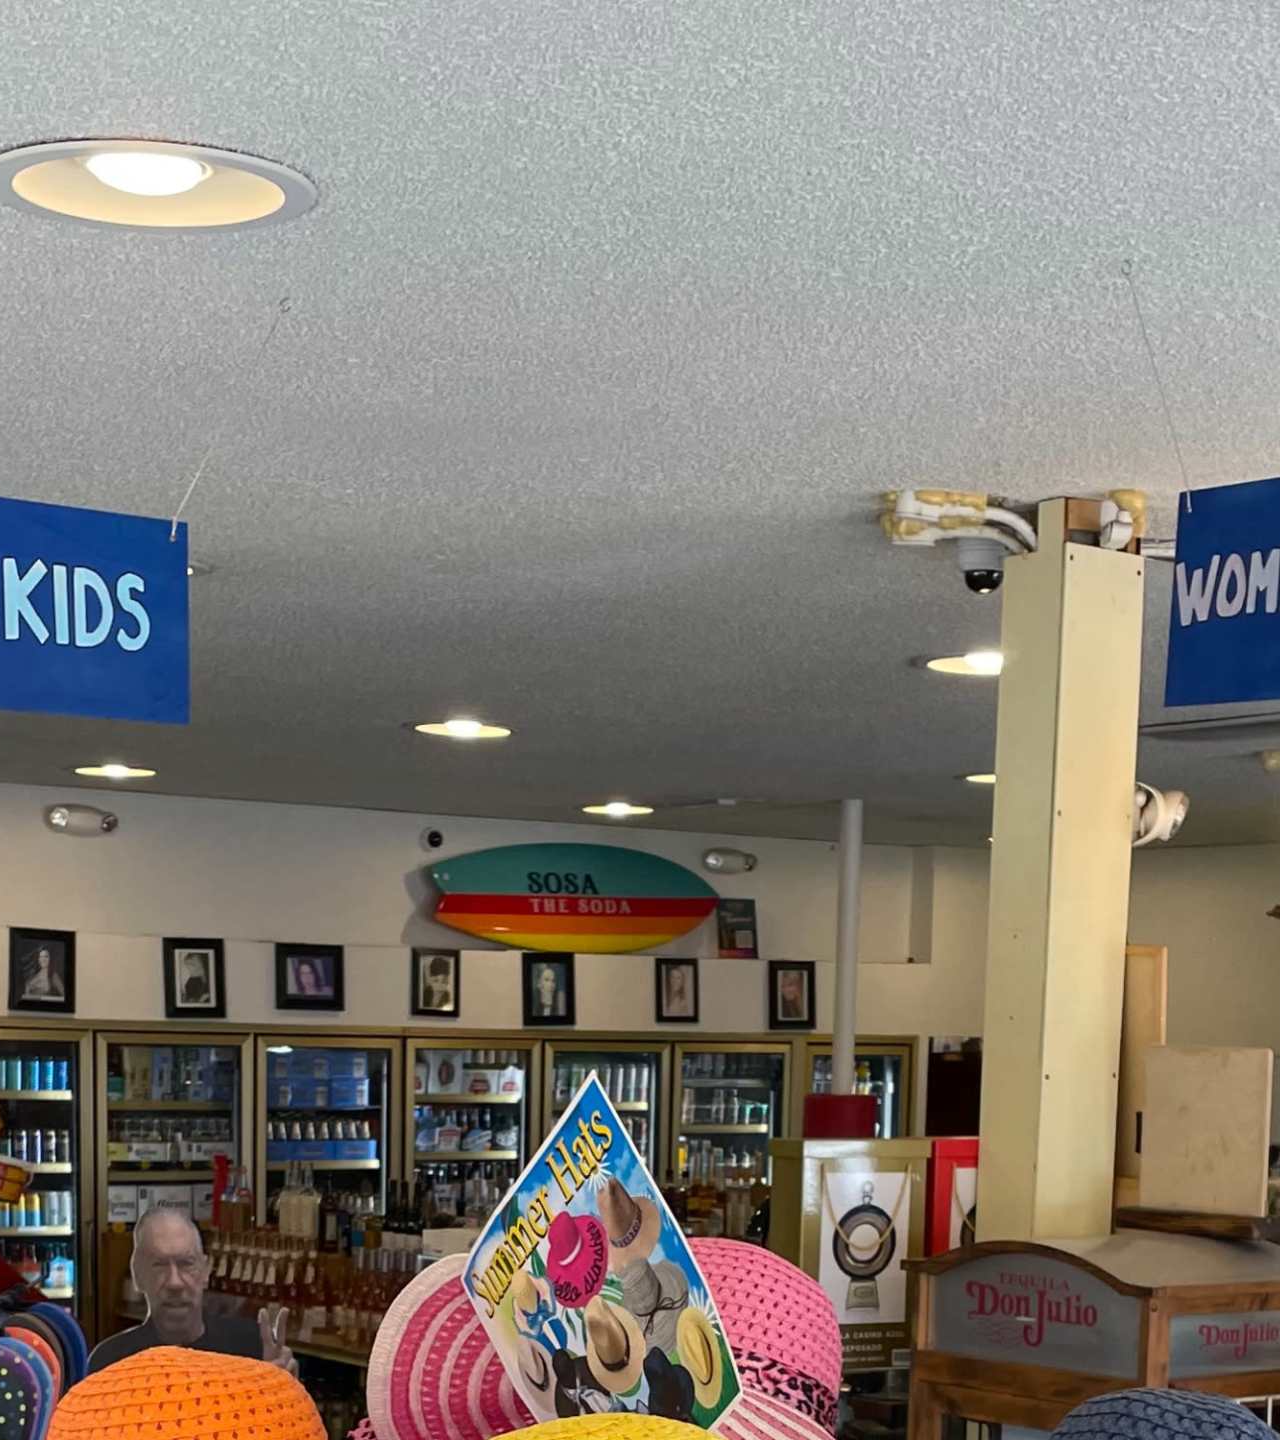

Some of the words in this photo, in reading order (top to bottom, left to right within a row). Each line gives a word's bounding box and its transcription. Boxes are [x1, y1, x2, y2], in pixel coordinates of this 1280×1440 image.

[2, 557, 151, 652] KIDS
[527, 872, 600, 896] SOSA
[528, 898, 570, 914] THE
[577, 899, 632, 914] SODA
[472, 1185, 556, 1319] Summer
[545, 1110, 613, 1206] Hats
[965, 1280, 1033, 1318] Don
[1019, 1288, 1098, 1348] Julio
[1198, 1323, 1240, 1347] Don
[1233, 1321, 1280, 1360] Julio
